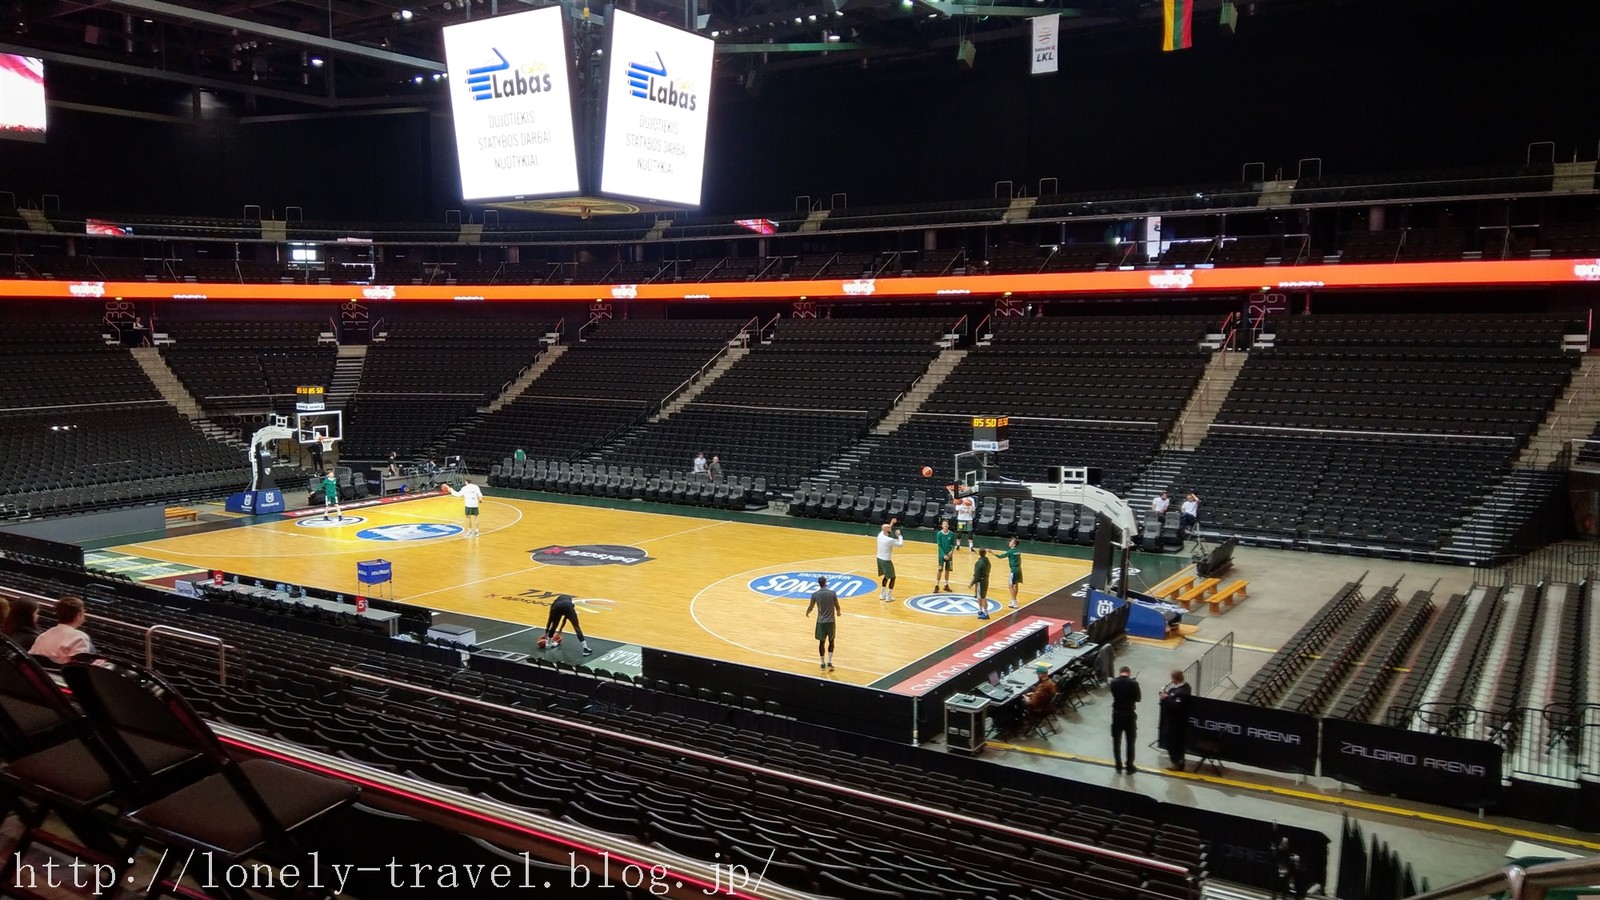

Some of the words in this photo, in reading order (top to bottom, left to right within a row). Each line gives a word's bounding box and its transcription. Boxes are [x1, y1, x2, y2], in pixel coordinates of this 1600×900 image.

[1036, 52, 1054, 62] LKL
[492, 69, 552, 98] Labas
[649, 76, 697, 111] Labas
[488, 110, 536, 129] DUJOTIEKIS
[477, 133, 519, 151] STATYBOS
[494, 154, 539, 170] NUOTYKIAI
[994, 298, 1009, 317] 22
[1009, 299, 1024, 317] 21
[1266, 293, 1287, 314] 19
[973, 418, 984, 427] 85
[985, 418, 997, 427] 50
[564, 549, 640, 563] betsafe
[756, 574, 863, 597] UTENOS
[358, 600, 365, 609] 5
[1247, 727, 1302, 745] ARENA
[1423, 757, 1486, 777] ARENA
